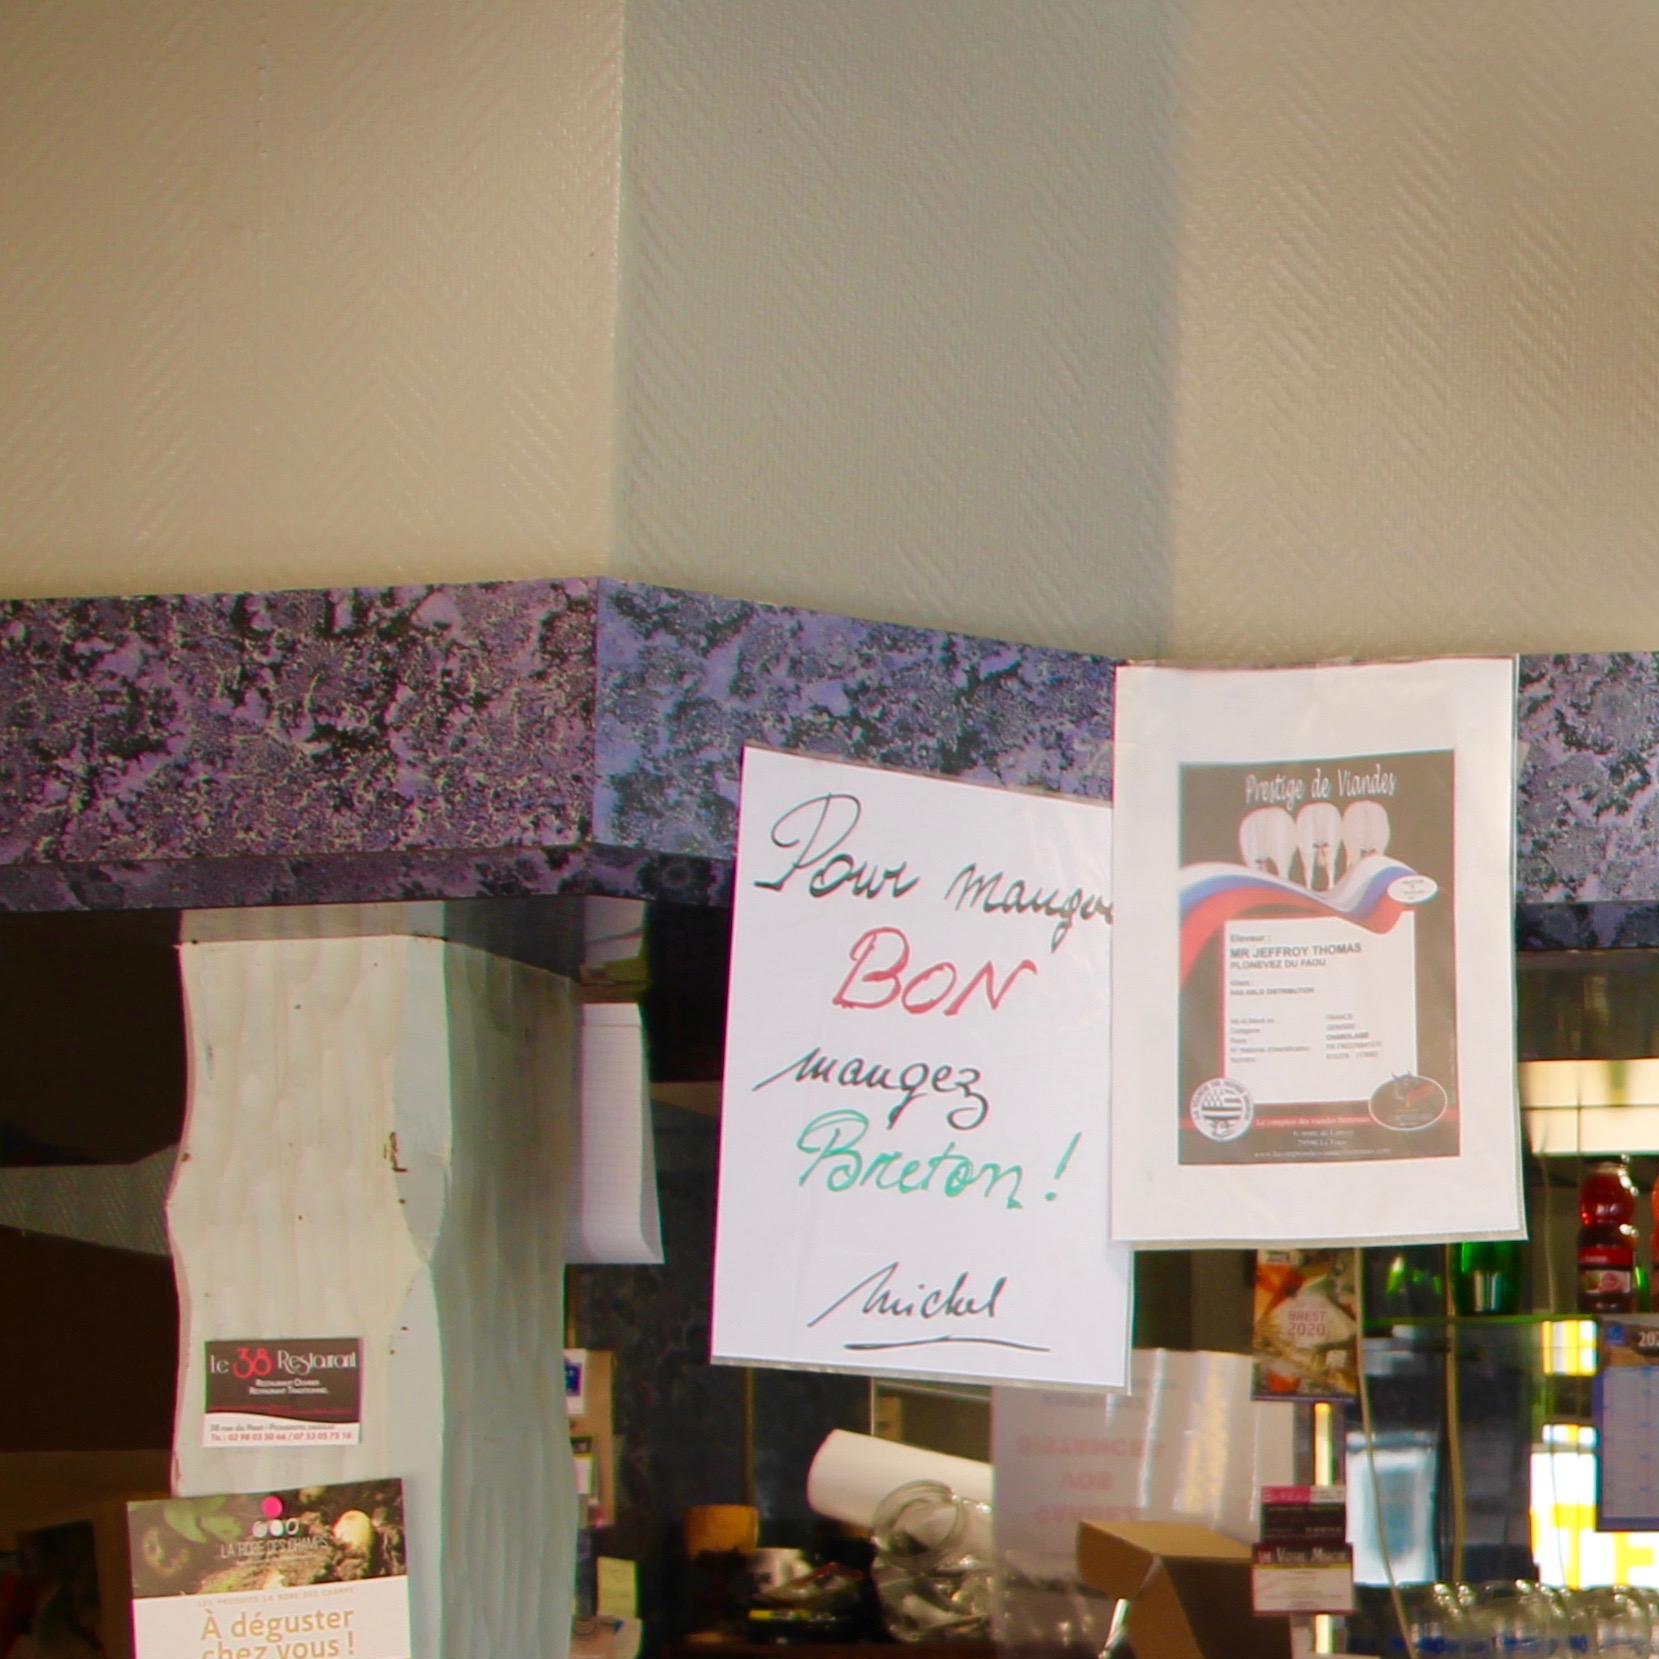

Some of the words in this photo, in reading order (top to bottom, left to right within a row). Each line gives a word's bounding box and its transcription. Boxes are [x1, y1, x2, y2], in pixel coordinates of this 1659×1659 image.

[1244, 773, 1305, 811] Prestige
[1311, 768, 1330, 799] de
[1337, 763, 1395, 797] Viandes
[753, 792, 920, 902] Pour
[1230, 947, 1250, 959] MR
[1253, 945, 1308, 958] JEFFROY
[1312, 942, 1362, 955] THOMAS
[1285, 959, 1298, 968] DU
[830, 926, 1038, 1017] BON
[753, 1047, 990, 1130] mangez
[795, 1108, 1024, 1211] Breton
[1044, 1132, 1082, 1202] !
[1288, 1311, 1326, 1323] BREST
[1288, 1323, 1326, 1336] 2020
[232, 1347, 273, 1379] 38
[201, 1608, 222, 1641] À
[230, 1609, 355, 1643] déguster
[347, 1631, 354, 1656] !
